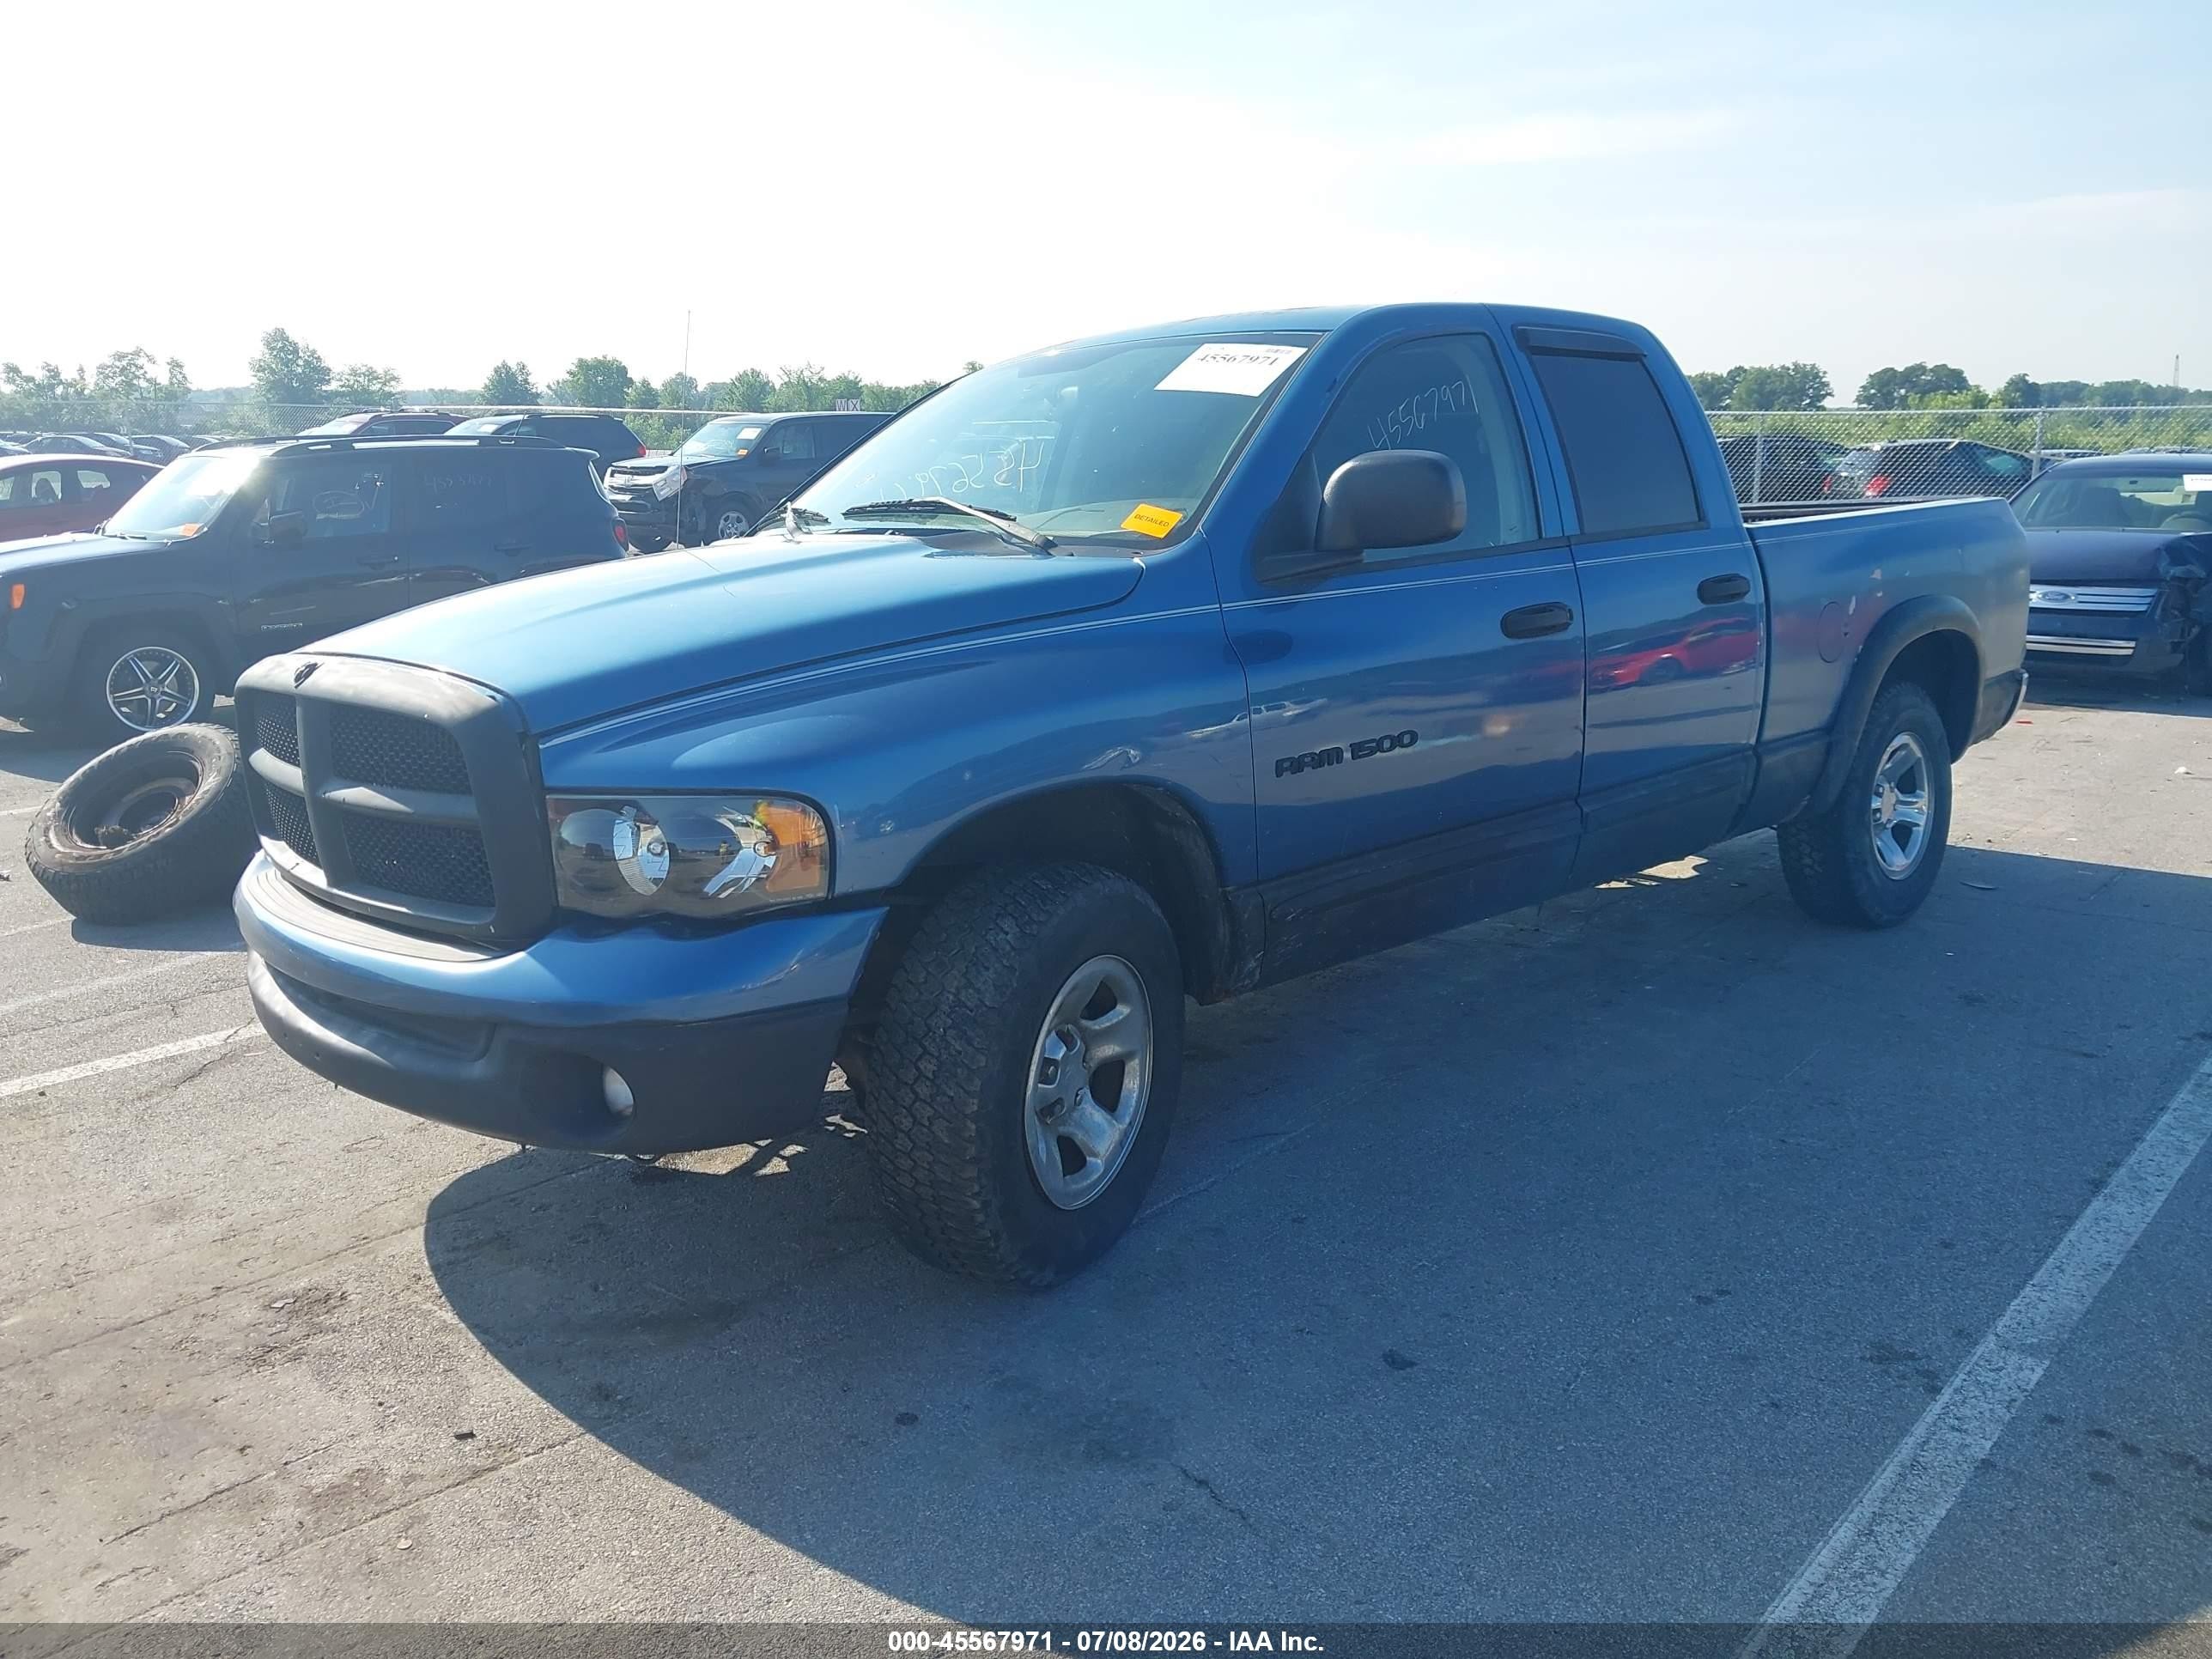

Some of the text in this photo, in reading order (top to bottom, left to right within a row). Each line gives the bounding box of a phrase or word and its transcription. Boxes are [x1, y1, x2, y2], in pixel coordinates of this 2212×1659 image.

[1198, 353, 1280, 366] 45567971
[1367, 374, 1479, 450] 45567971
[1133, 514, 1170, 527] DETAILED
[1275, 730, 1419, 778] RAM 1500
